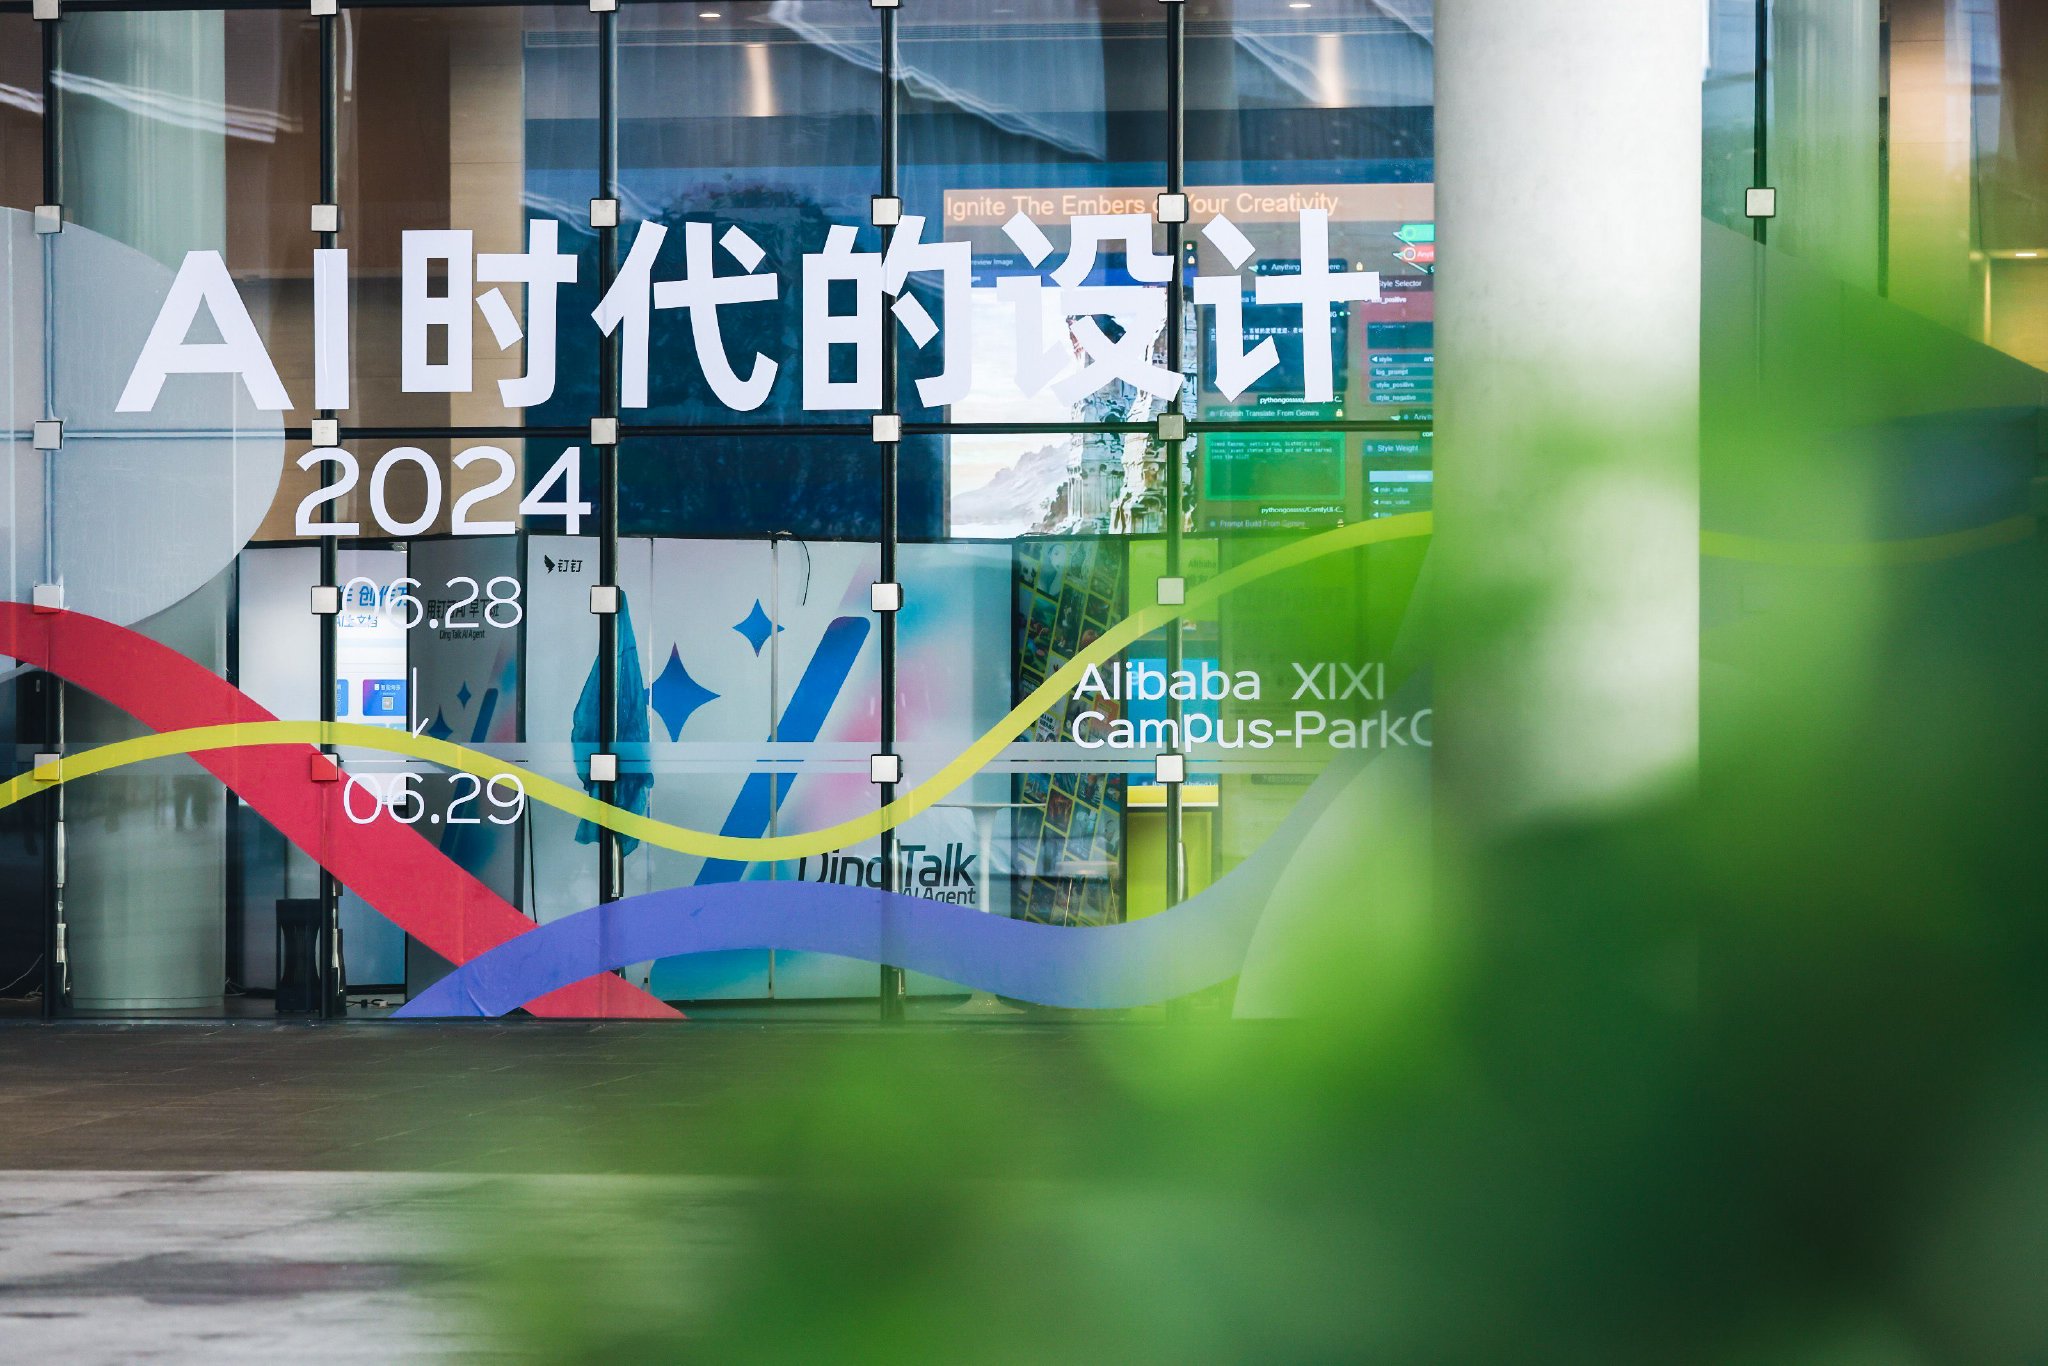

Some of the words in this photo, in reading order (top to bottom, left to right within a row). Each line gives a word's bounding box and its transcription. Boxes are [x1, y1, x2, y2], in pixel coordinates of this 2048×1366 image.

[946, 196, 1006, 221] Ignite
[1012, 195, 1054, 215] The
[1062, 194, 1146, 216] Embers
[1236, 191, 1339, 218] Creativity
[1271, 263, 1300, 272] Anything
[1394, 279, 1422, 287] Selector
[115, 249, 350, 413] AI
[402, 209, 1380, 412] 时代的设计
[1220, 409, 1244, 419] English
[1246, 409, 1275, 417] Translate
[1277, 409, 1294, 417] From
[1377, 445, 1393, 453] Style
[295, 446, 591, 536] 2024
[557, 559, 583, 573] 钉钉
[342, 576, 523, 629] 06.28
[1072, 662, 1261, 701] Alibaba
[1290, 662, 1385, 700] XIXI
[342, 772, 525, 825] 06.29
[900, 842, 977, 888] Talk
